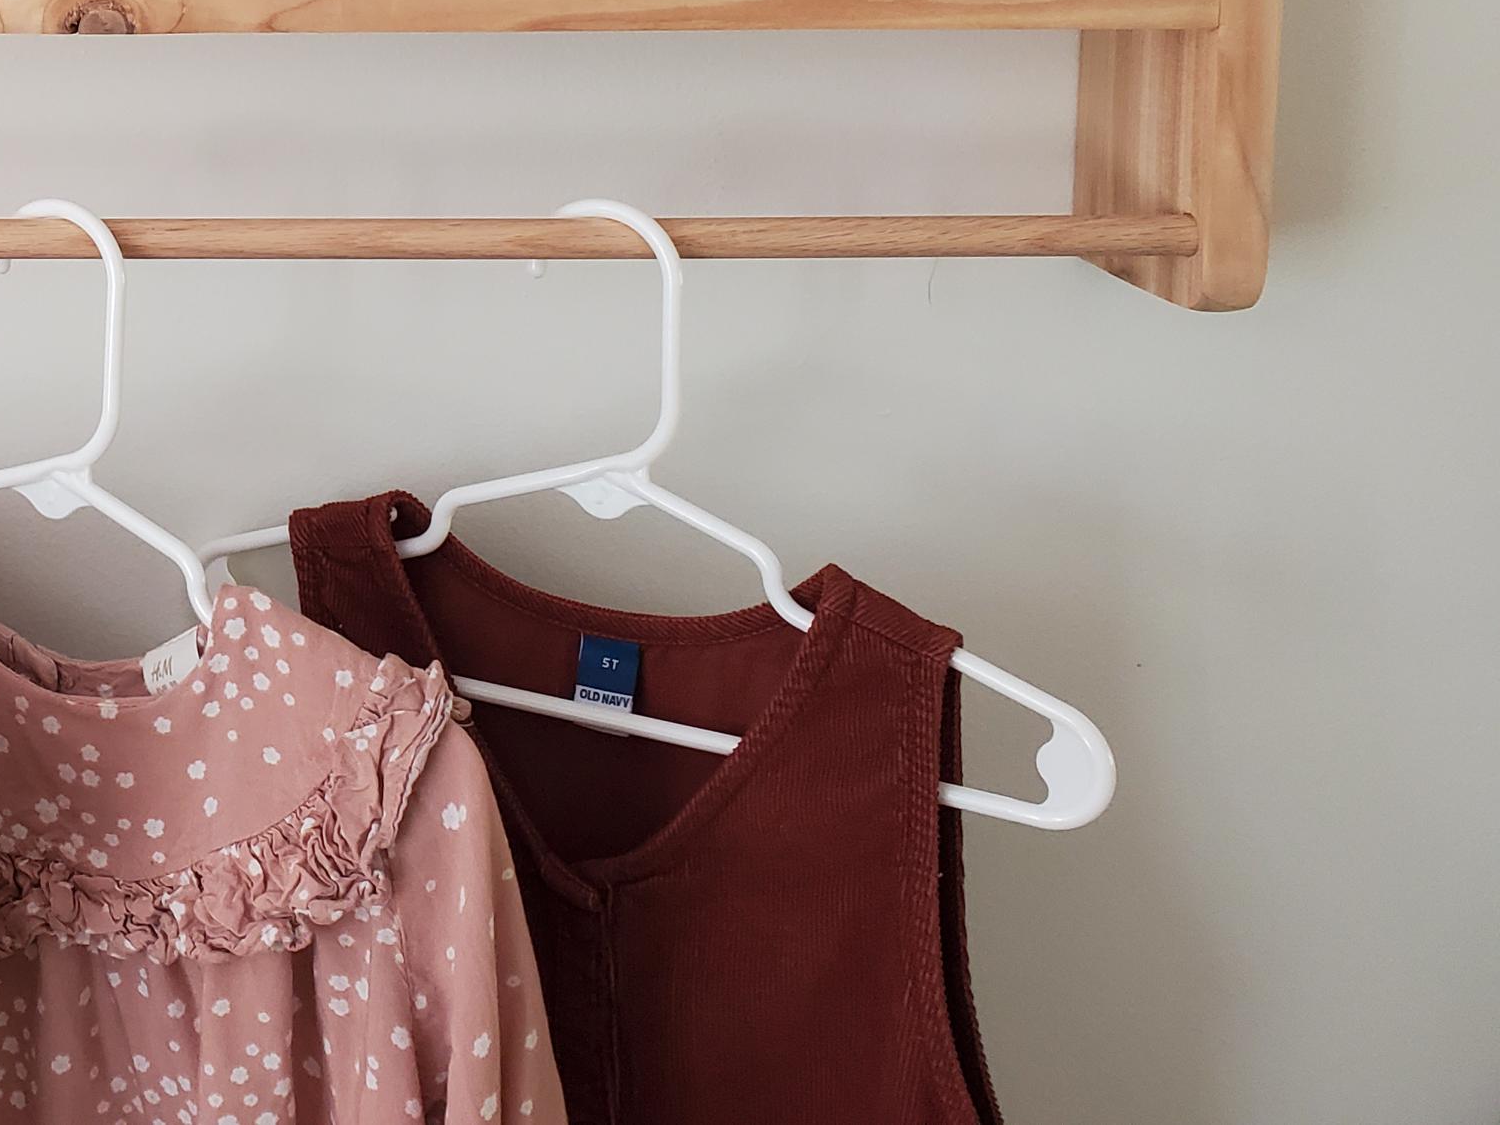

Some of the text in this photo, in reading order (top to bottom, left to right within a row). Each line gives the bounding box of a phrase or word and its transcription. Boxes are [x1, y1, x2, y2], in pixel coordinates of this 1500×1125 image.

[602, 657, 619, 670] 5T
[579, 688, 630, 708] OLD NAVY
